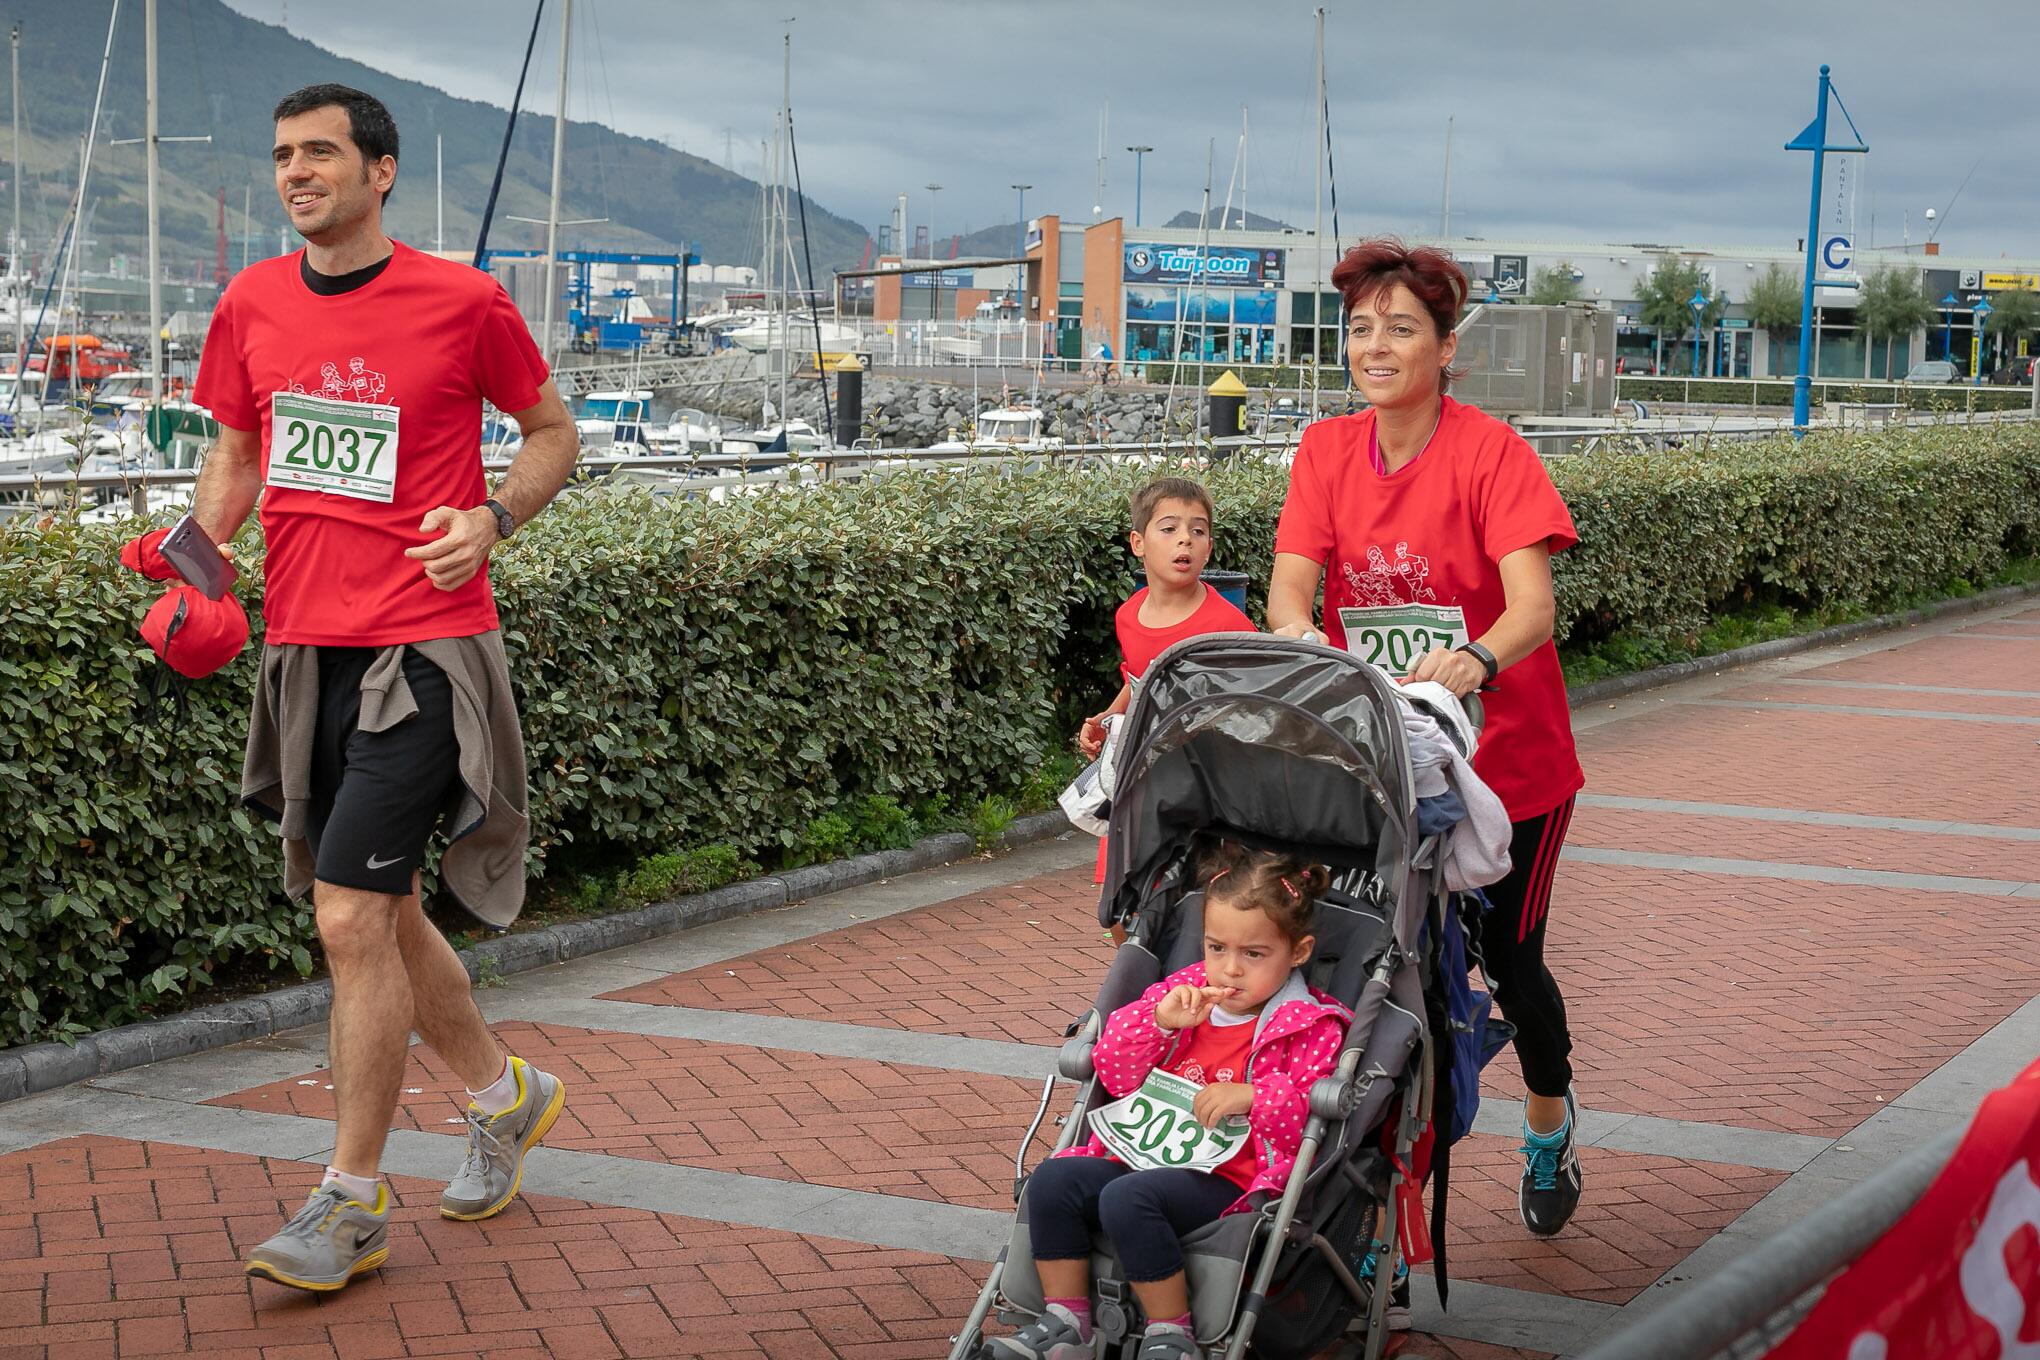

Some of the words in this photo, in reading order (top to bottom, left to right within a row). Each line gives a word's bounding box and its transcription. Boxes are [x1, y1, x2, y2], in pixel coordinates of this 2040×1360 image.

[1835, 158, 1847, 224] PANTALAN
[1159, 251, 1250, 275] Tarpoon
[1823, 236, 1852, 270] C
[285, 421, 388, 476] 2037
[1354, 1061, 1388, 1110] REN
